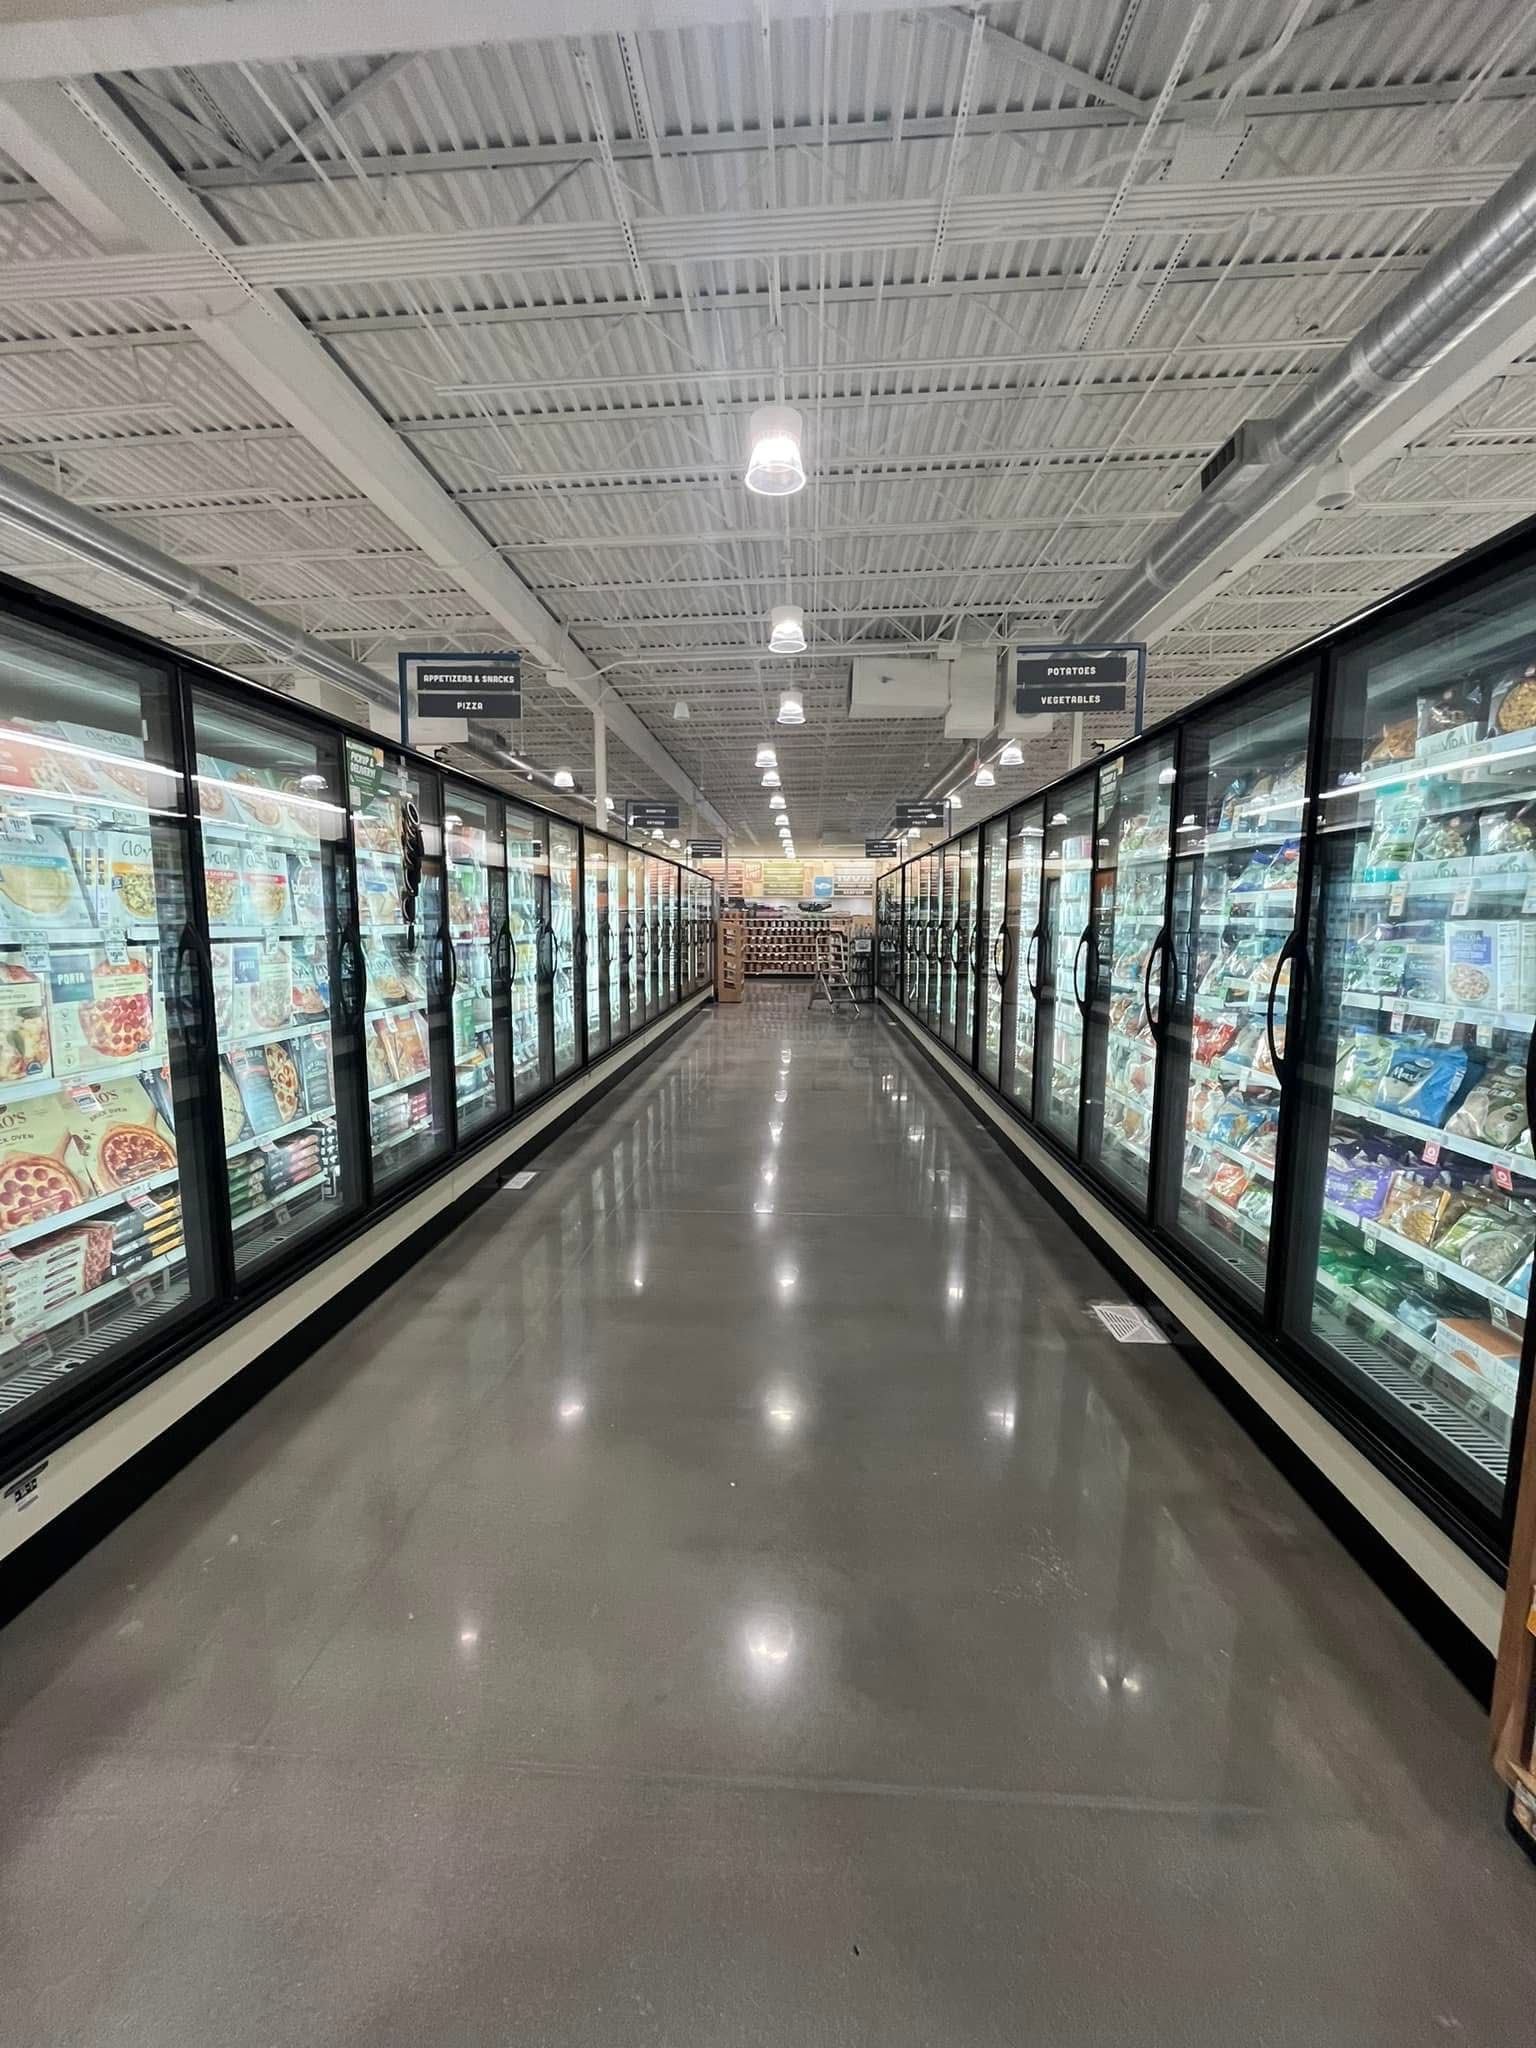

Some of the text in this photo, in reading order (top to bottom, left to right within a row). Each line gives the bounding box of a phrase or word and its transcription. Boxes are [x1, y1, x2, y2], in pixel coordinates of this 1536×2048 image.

[1047, 666, 1096, 676] POTATOES
[423, 674, 515, 684] APPETIZERS & SNACKS
[1040, 695, 1101, 705] VEGETABLES
[456, 701, 483, 710] PIZZA
